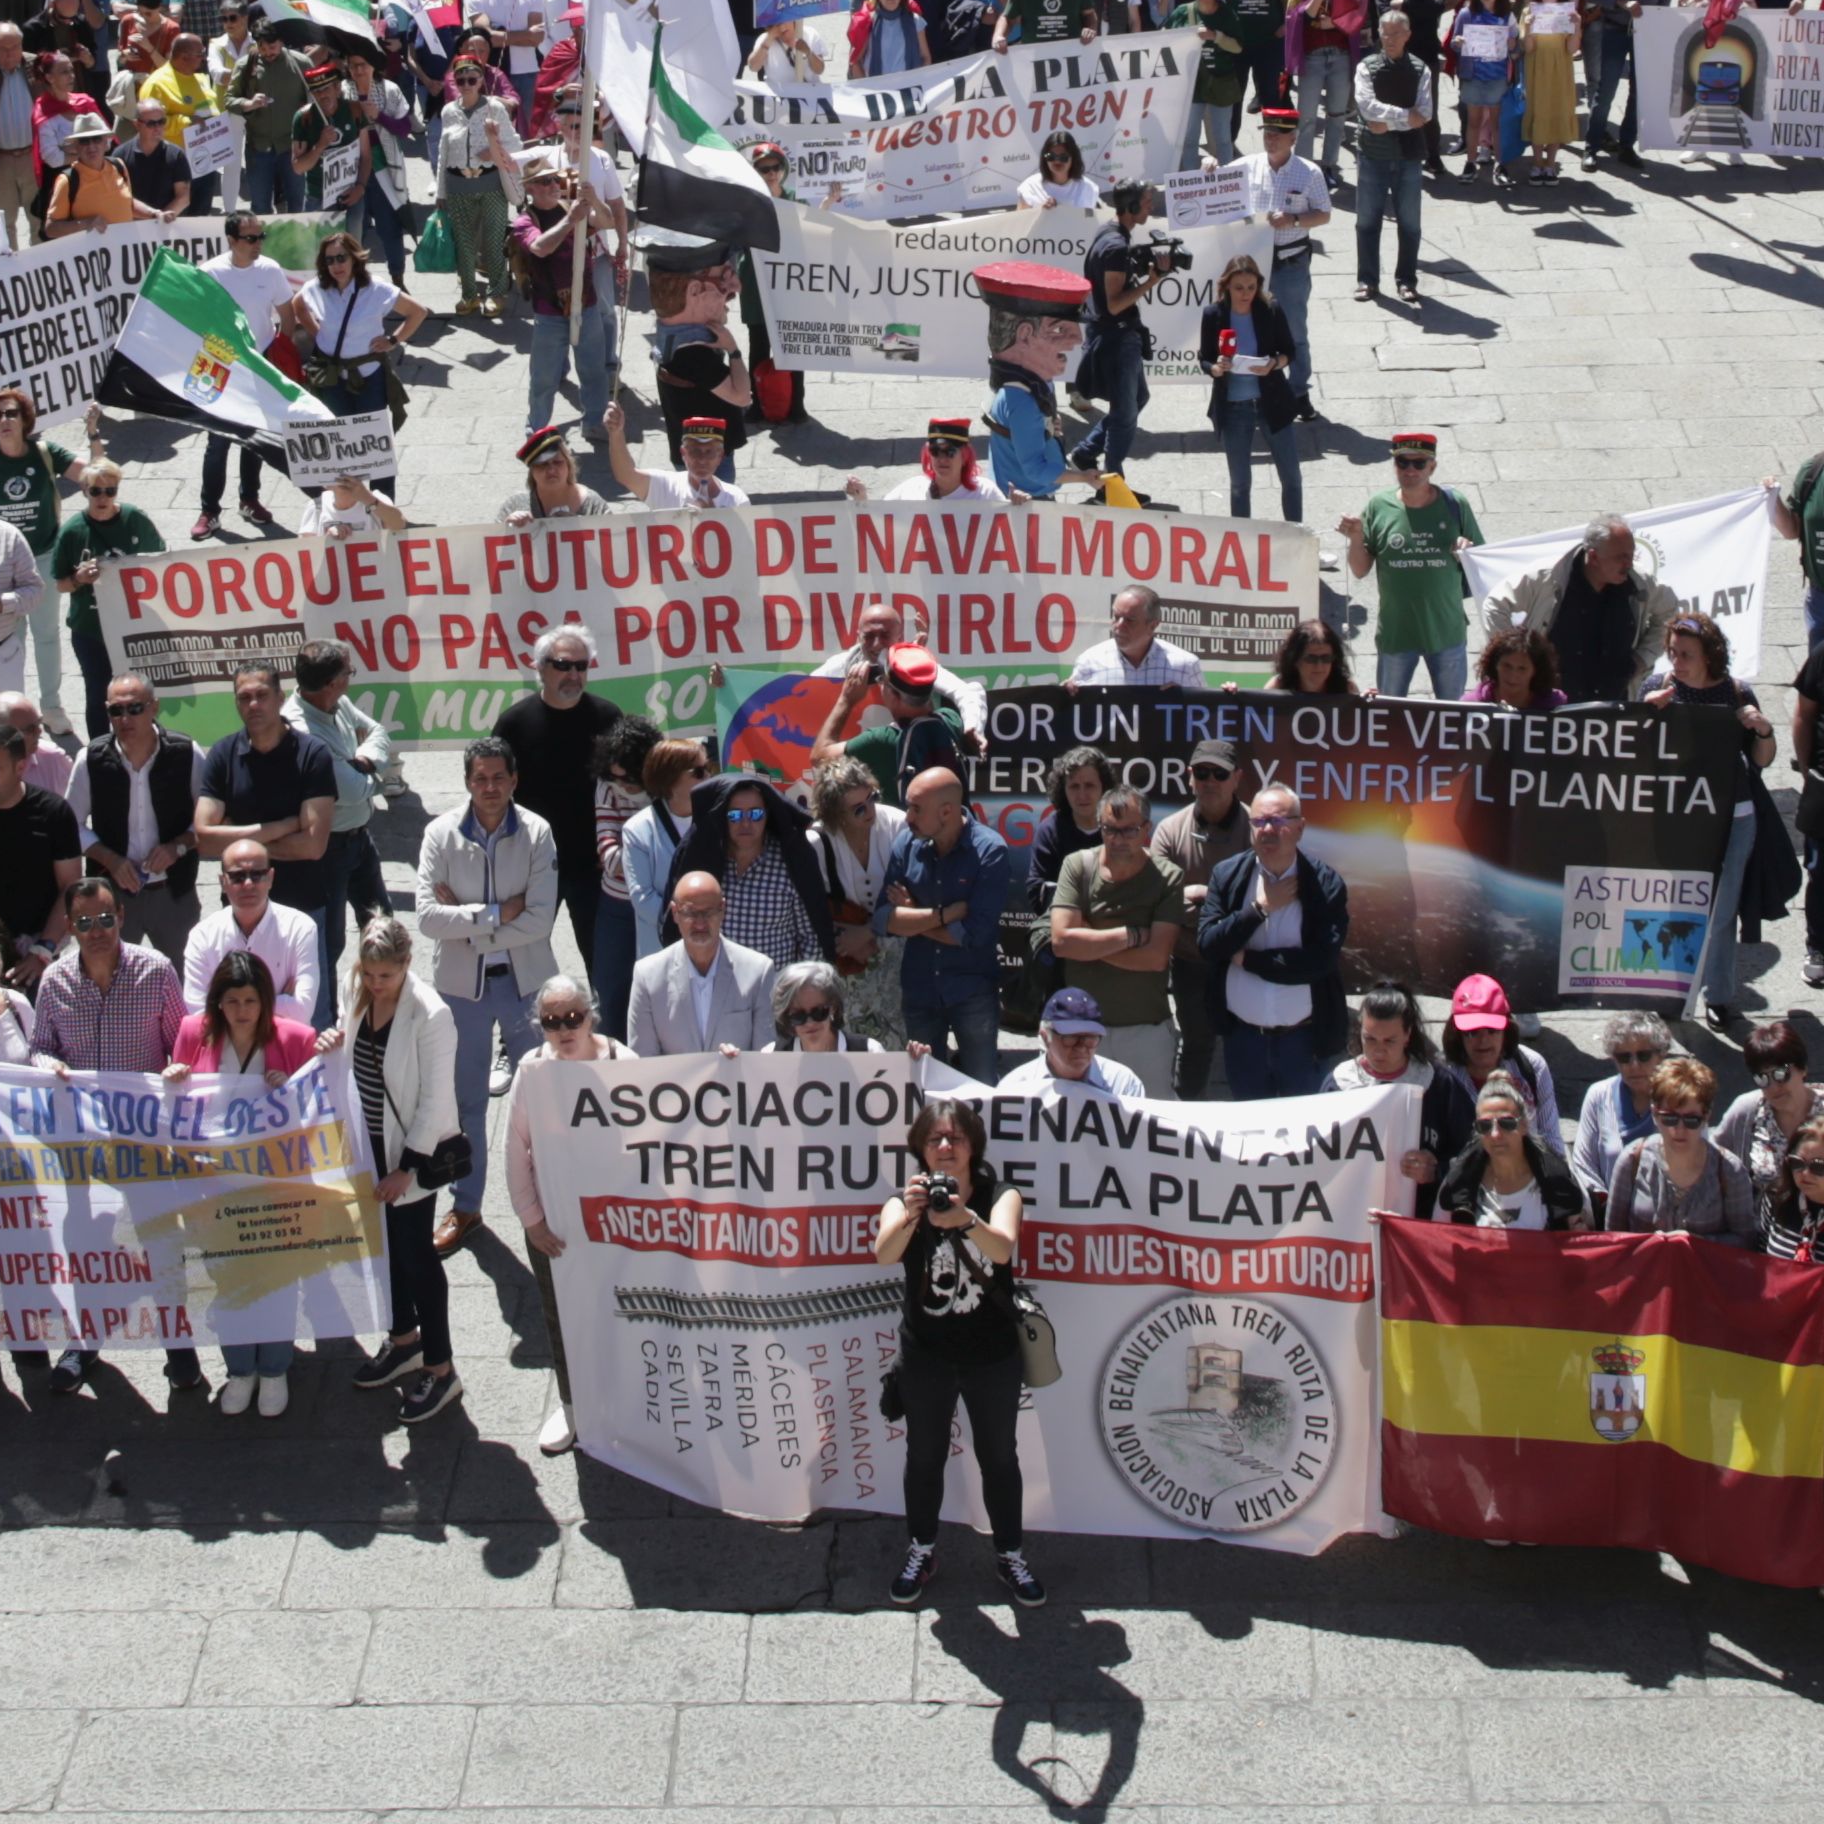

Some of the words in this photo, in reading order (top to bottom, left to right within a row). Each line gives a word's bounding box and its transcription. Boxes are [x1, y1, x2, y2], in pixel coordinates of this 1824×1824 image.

[865, 84, 928, 123] DE
[954, 64, 1008, 103] LA
[1031, 45, 1182, 94] PLATA
[1777, 55, 1821, 81] RUTA
[1029, 87, 1129, 134] TREN
[798, 151, 829, 178] NO
[833, 155, 866, 175] MURO
[895, 229, 1087, 256] redautonomos
[76, 248, 112, 298] POR
[764, 260, 861, 298] TREN,
[75, 304, 99, 351] EL
[31, 373, 61, 418] EL
[286, 432, 331, 463] NO
[336, 434, 393, 459] MURO
[118, 540, 385, 620] PORQUE
[398, 537, 470, 597] EL
[483, 518, 733, 596] FUTURO
[754, 514, 840, 578] DE
[856, 511, 1290, 593] NAVALMORAL
[333, 613, 423, 673] NO
[614, 594, 744, 666] POR
[1073, 704, 1140, 743] UN
[1154, 704, 1275, 745] TREN
[1290, 707, 1389, 751] QUE
[1252, 759, 1276, 798] Y
[1508, 768, 1717, 816] PLANETA
[1574, 875, 1710, 907] ASTURIES
[1572, 910, 1612, 930] POL
[1569, 945, 1660, 974] CLIMA
[11, 1086, 57, 1136] EN
[66, 1086, 160, 1138] TODO
[170, 1095, 211, 1142] EL
[224, 1064, 336, 1138] OESTE
[43, 1143, 108, 1182] RUTA
[115, 1143, 147, 1178] DE
[154, 1144, 188, 1176] LA
[626, 1140, 774, 1193] TREN
[1057, 1162, 1132, 1210] LA
[1148, 1171, 1335, 1227] PLATA
[598, 1203, 800, 1259] ¡NECESITAMOS
[1036, 1230, 1075, 1274] ES
[1083, 1232, 1223, 1287] NUESTRO
[1231, 1248, 1370, 1294] FUTURO!!
[21, 1308, 58, 1342] DE
[64, 1307, 97, 1340] LA
[103, 1305, 194, 1341] PLATA
[1231, 1304, 1288, 1346] TREN
[640, 1339, 663, 1425] CÁDIZ
[1108, 1304, 1218, 1413] BENAVENTANA
[1283, 1343, 1326, 1403] RUTA
[665, 1342, 694, 1455] SEVILLA
[696, 1342, 725, 1435] ZAFRA
[730, 1342, 761, 1450] MÉRIDA
[763, 1341, 803, 1470] CÁCERES
[806, 1343, 841, 1487] PLASENCIA
[840, 1335, 877, 1502] SALAMANCA
[1303, 1413, 1331, 1444] DE
[1290, 1449, 1323, 1484] LA
[1236, 1480, 1299, 1524] PLATA
